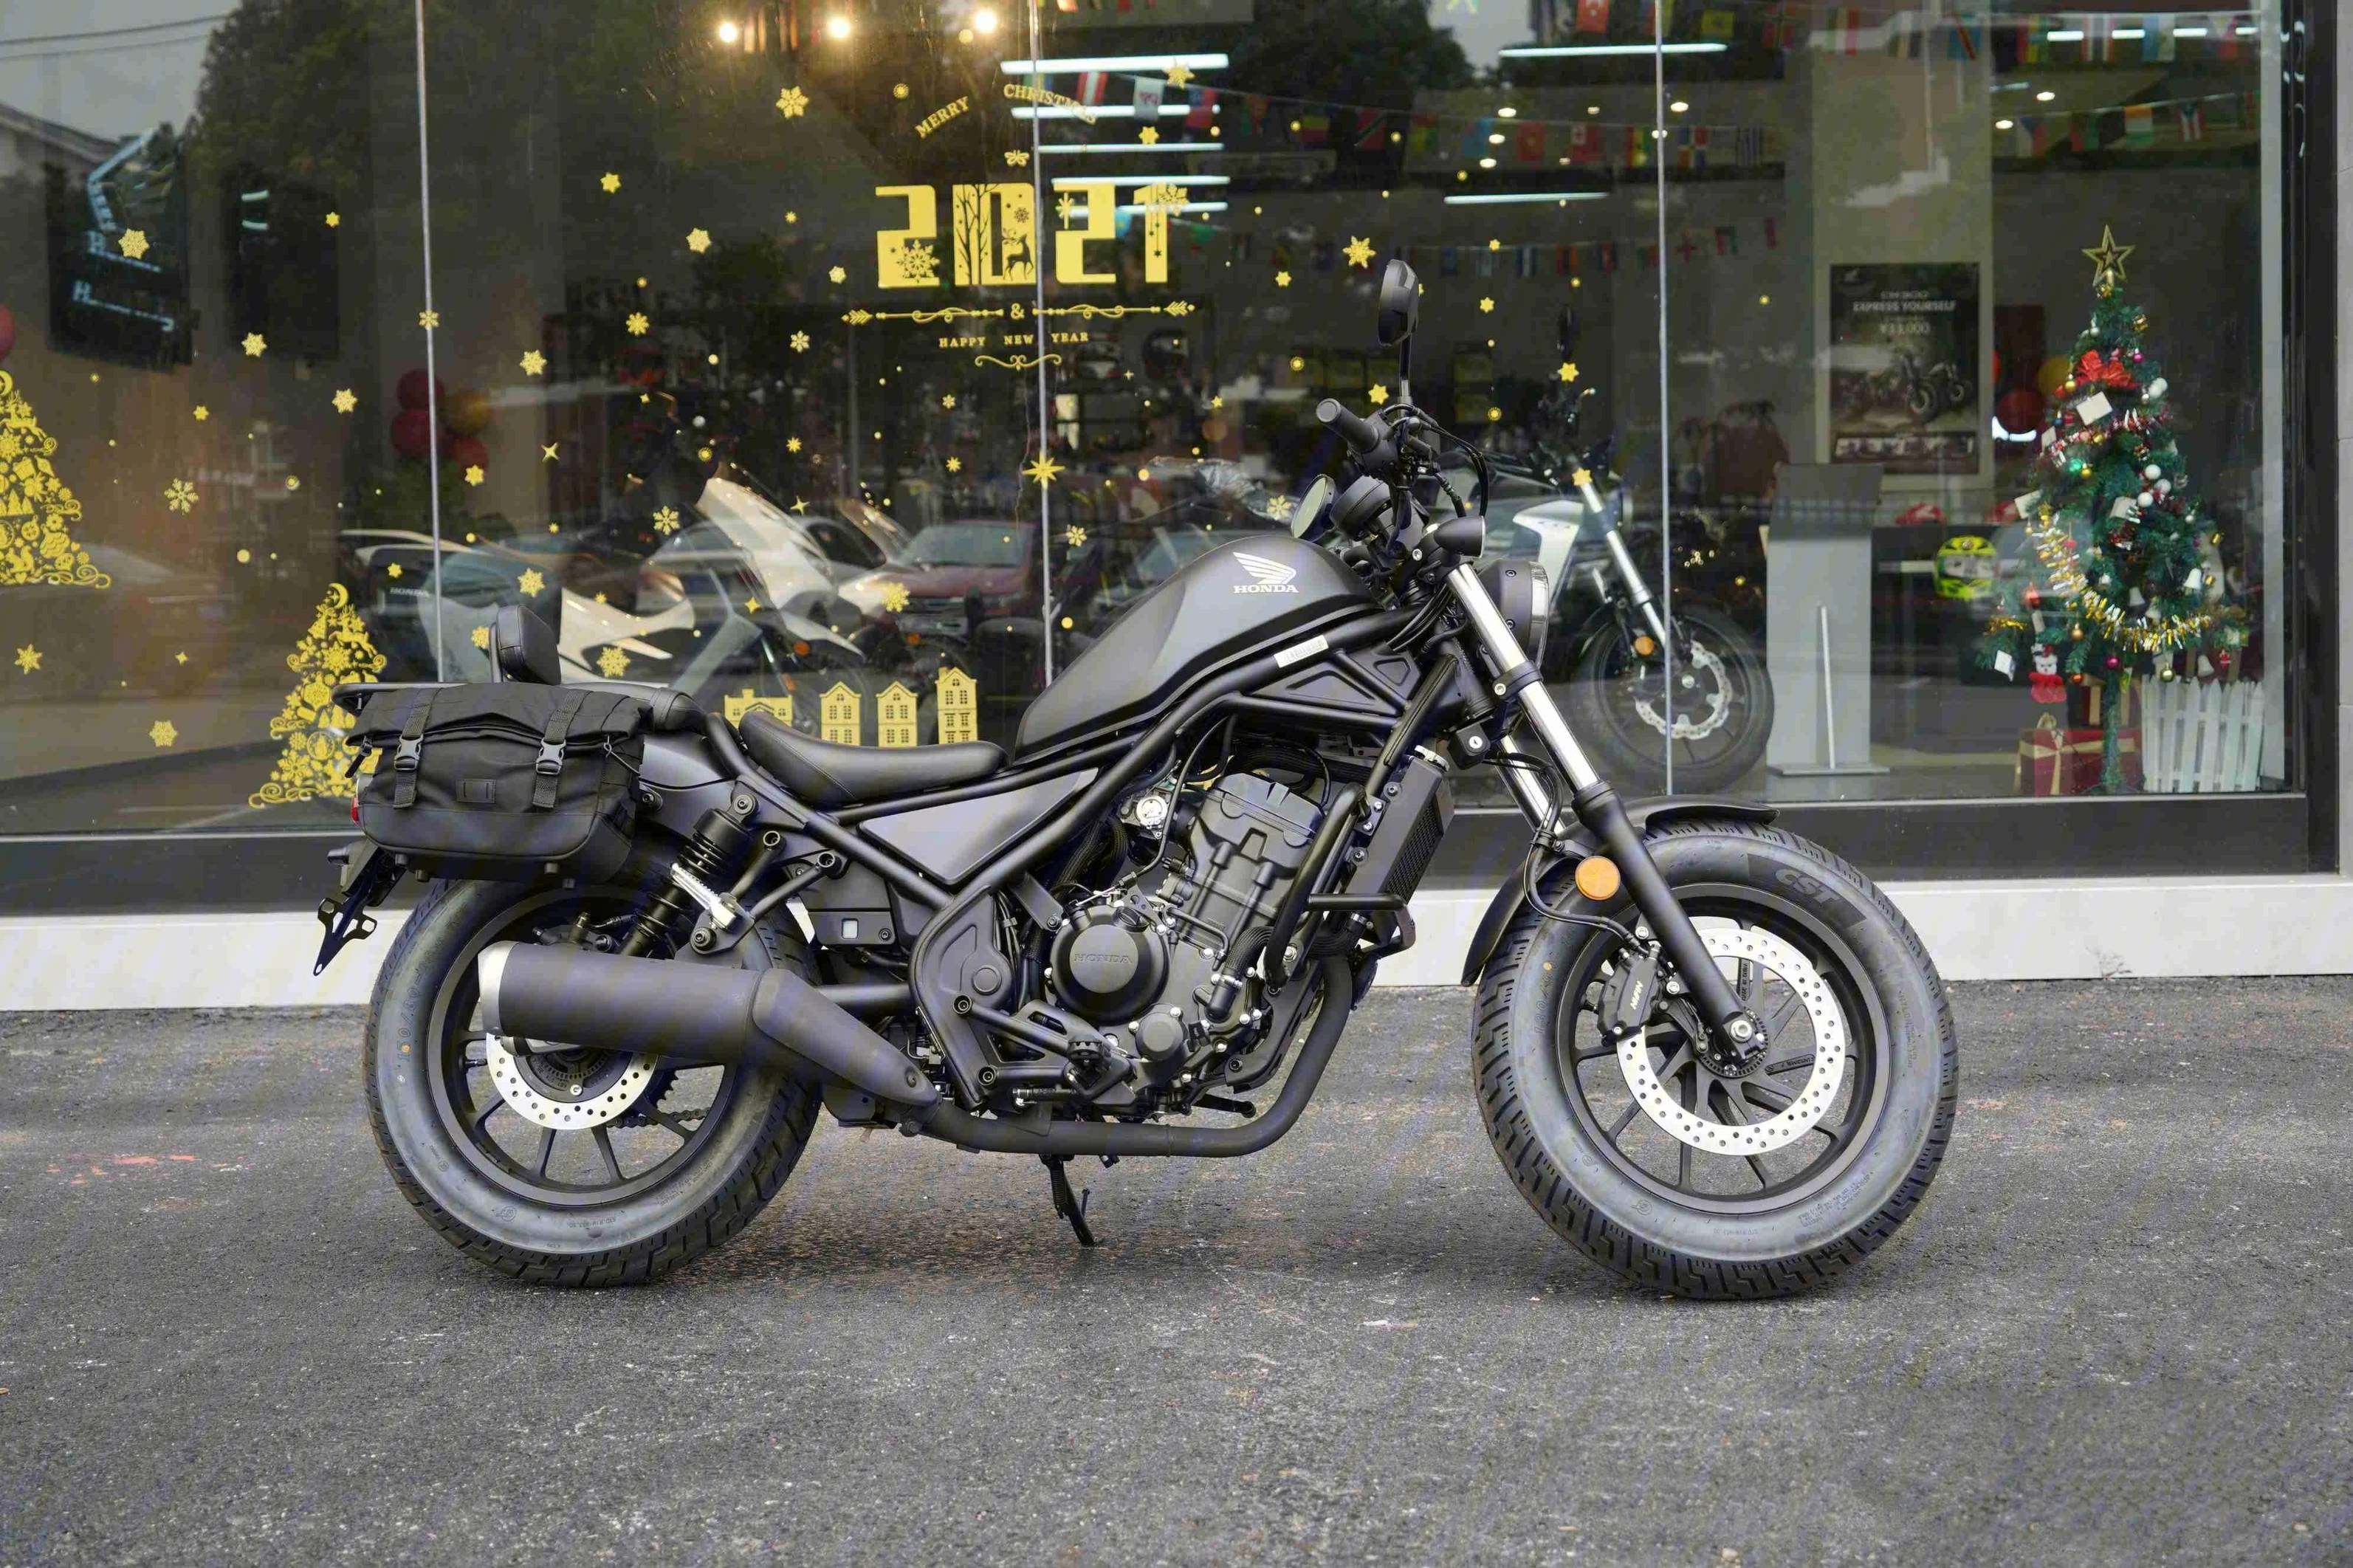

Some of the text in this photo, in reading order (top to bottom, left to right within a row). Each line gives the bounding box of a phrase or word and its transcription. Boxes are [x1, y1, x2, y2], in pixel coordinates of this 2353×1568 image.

[915, 83, 1096, 139] MERRY CHRISTMAS
[875, 182, 1169, 288] 2021
[1010, 302, 1025, 320] &
[939, 331, 1089, 348] HAPPY NEW YEAR
[1233, 584, 1299, 594] HONDA
[1775, 868, 1843, 904] CST
[1074, 953, 1133, 963] HONDA
